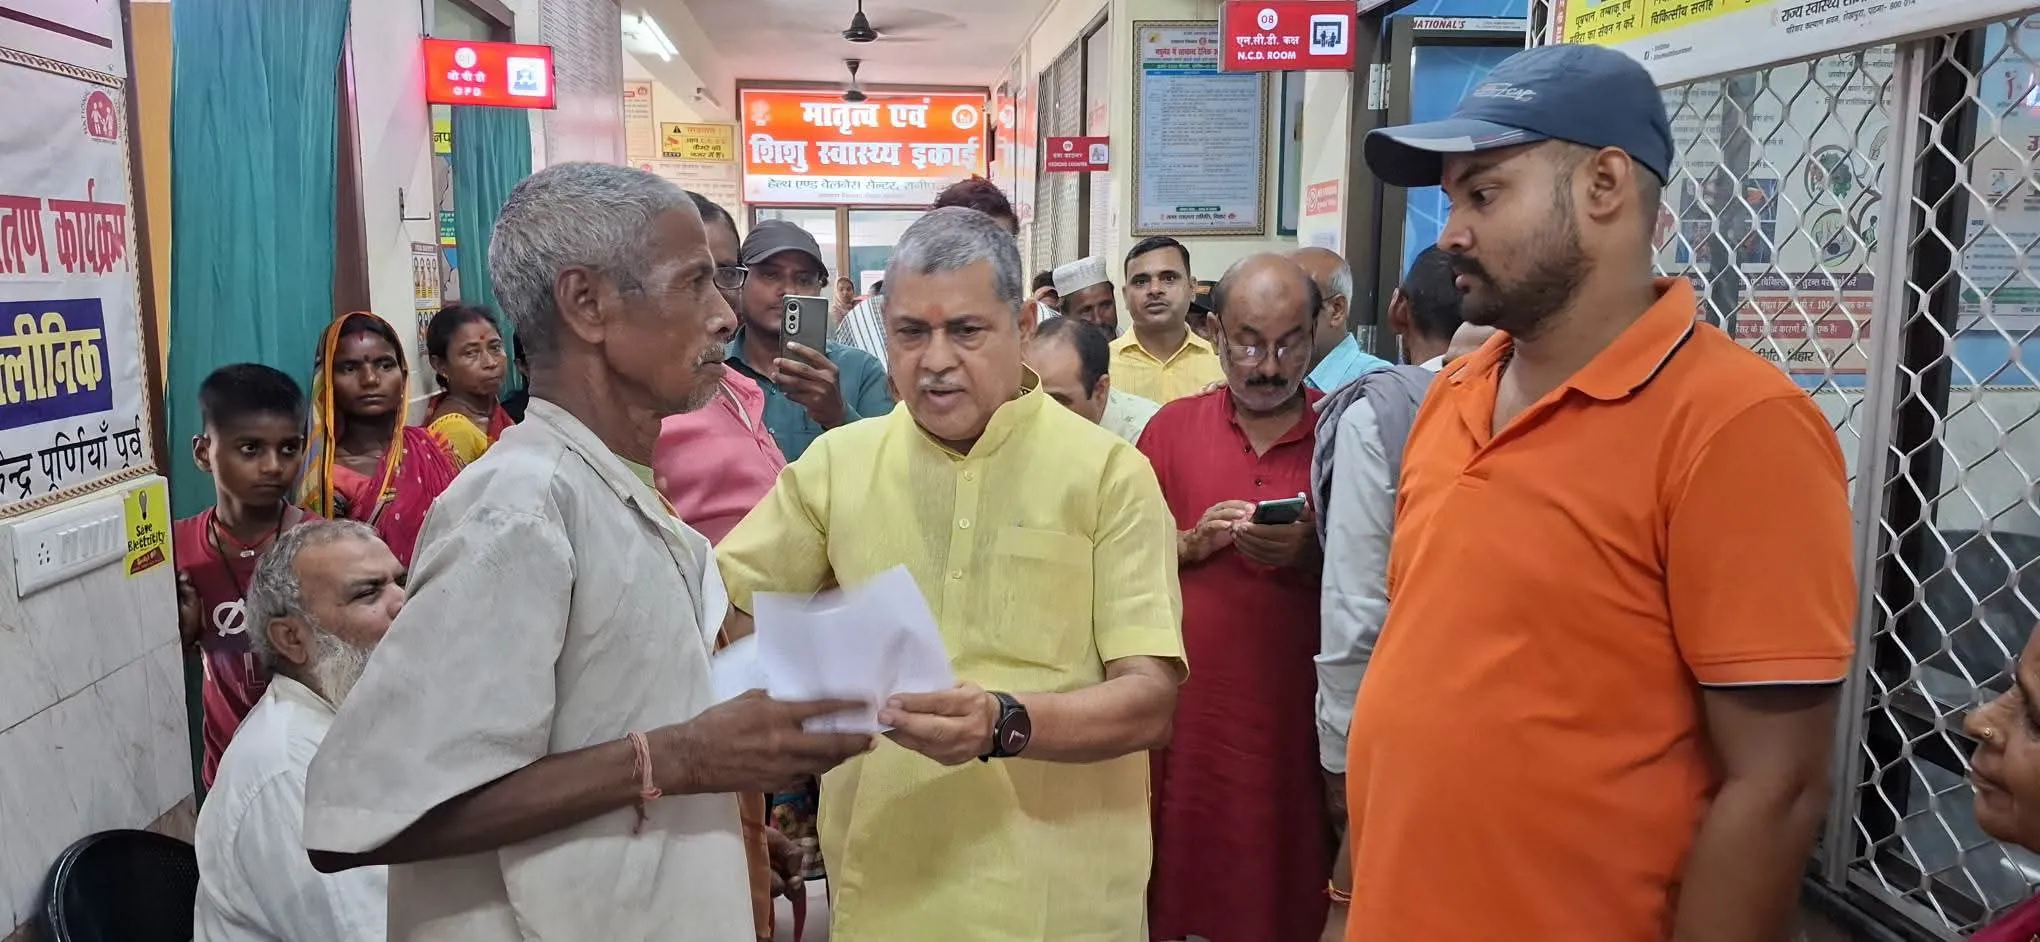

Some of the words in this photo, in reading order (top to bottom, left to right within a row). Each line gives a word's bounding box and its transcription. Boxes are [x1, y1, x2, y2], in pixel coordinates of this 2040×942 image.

[1261, 15, 1274, 24] 08
[1781, 6, 1802, 23] राज्य
[1237, 51, 1264, 60] N.C.D.
[1267, 51, 1297, 60] ROOM
[887, 97, 930, 128] एवं
[749, 133, 808, 173] शिशु
[909, 136, 979, 170] इकाई
[48, 178, 130, 277] कार्यक्रम
[38, 419, 109, 492] पूर्णियाँ
[113, 414, 144, 468] पूर्व
[136, 522, 153, 538] Save
